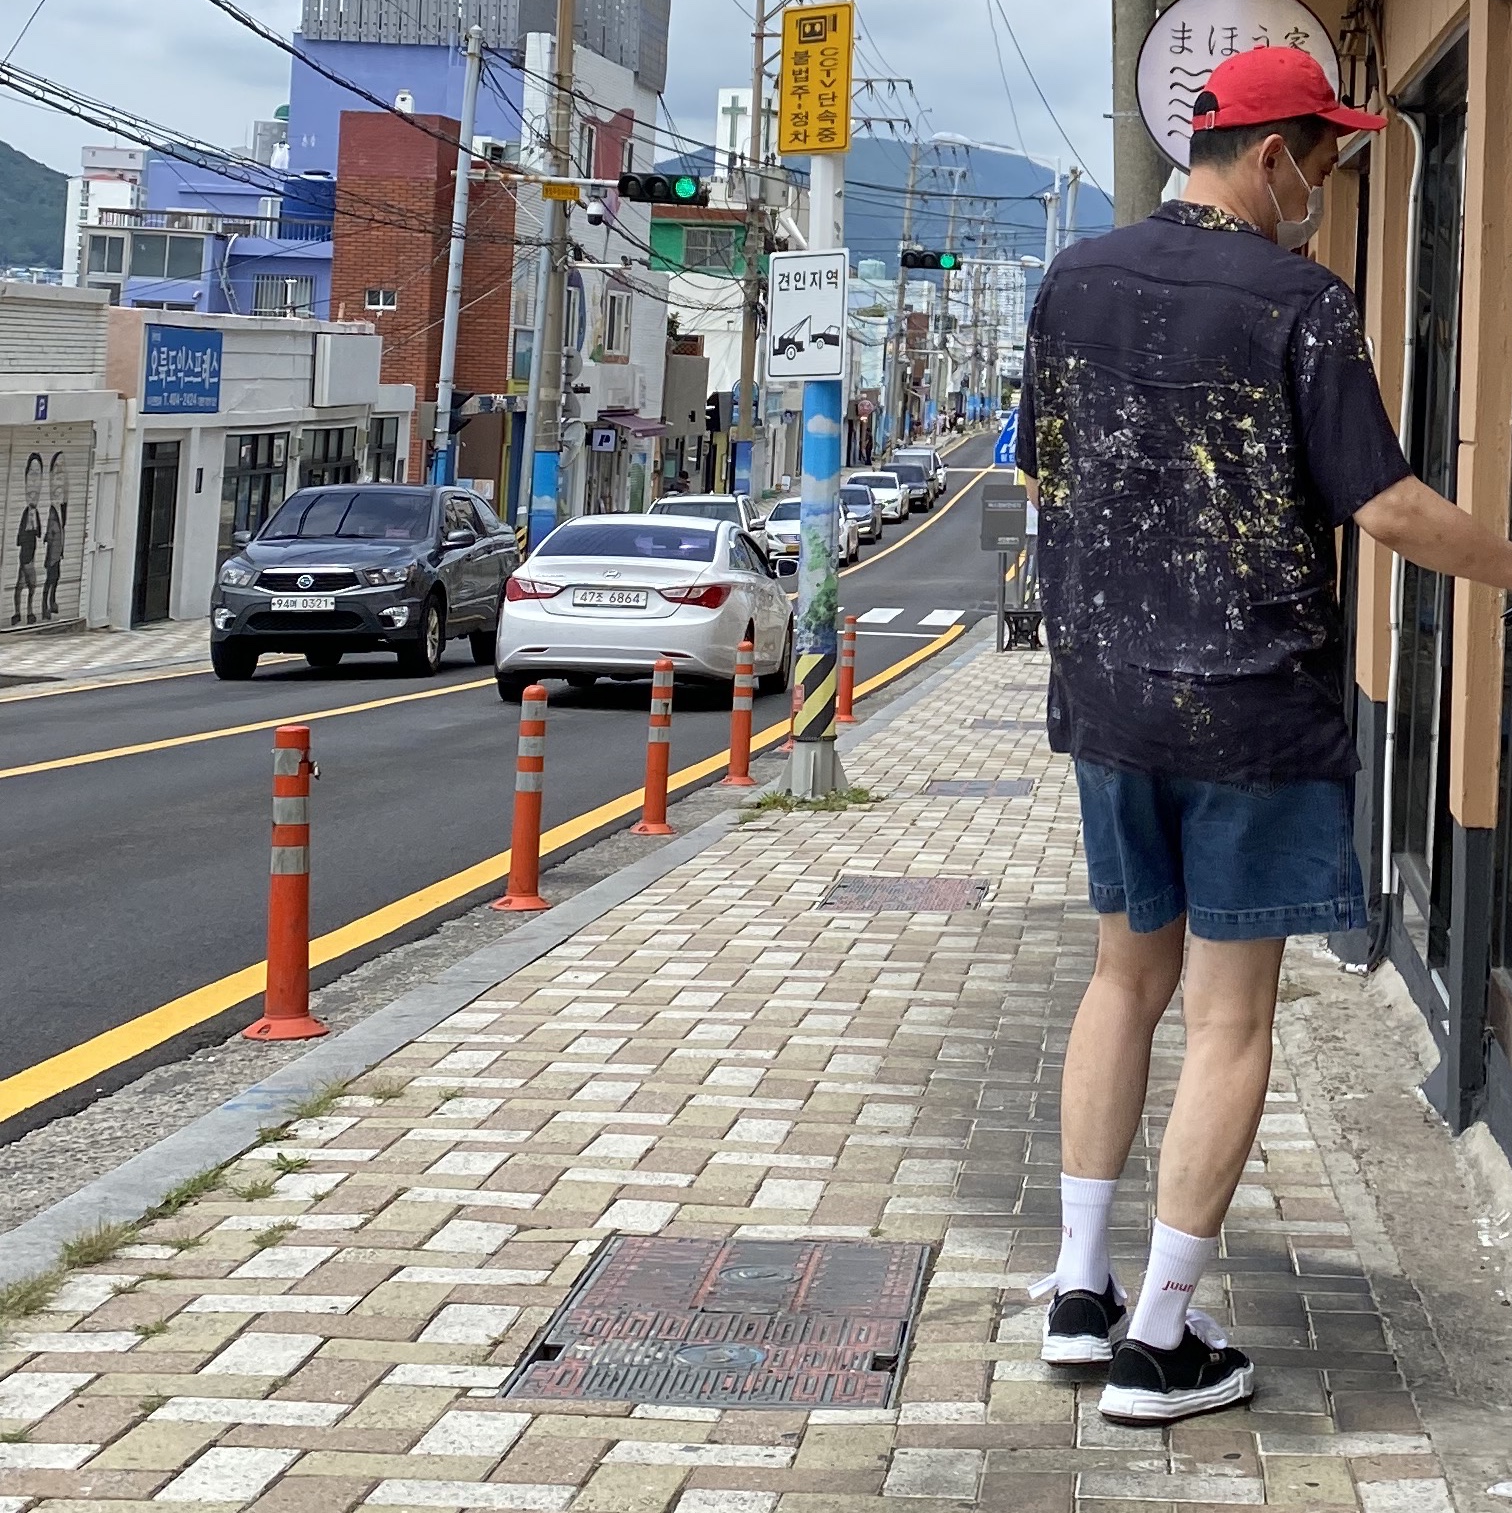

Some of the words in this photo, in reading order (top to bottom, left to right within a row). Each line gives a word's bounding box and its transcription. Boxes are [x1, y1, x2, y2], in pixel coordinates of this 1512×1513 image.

[777, 268, 839, 292] 견인지역
[301, 598, 329, 609] 0321
[609, 592, 640, 604] 6864
